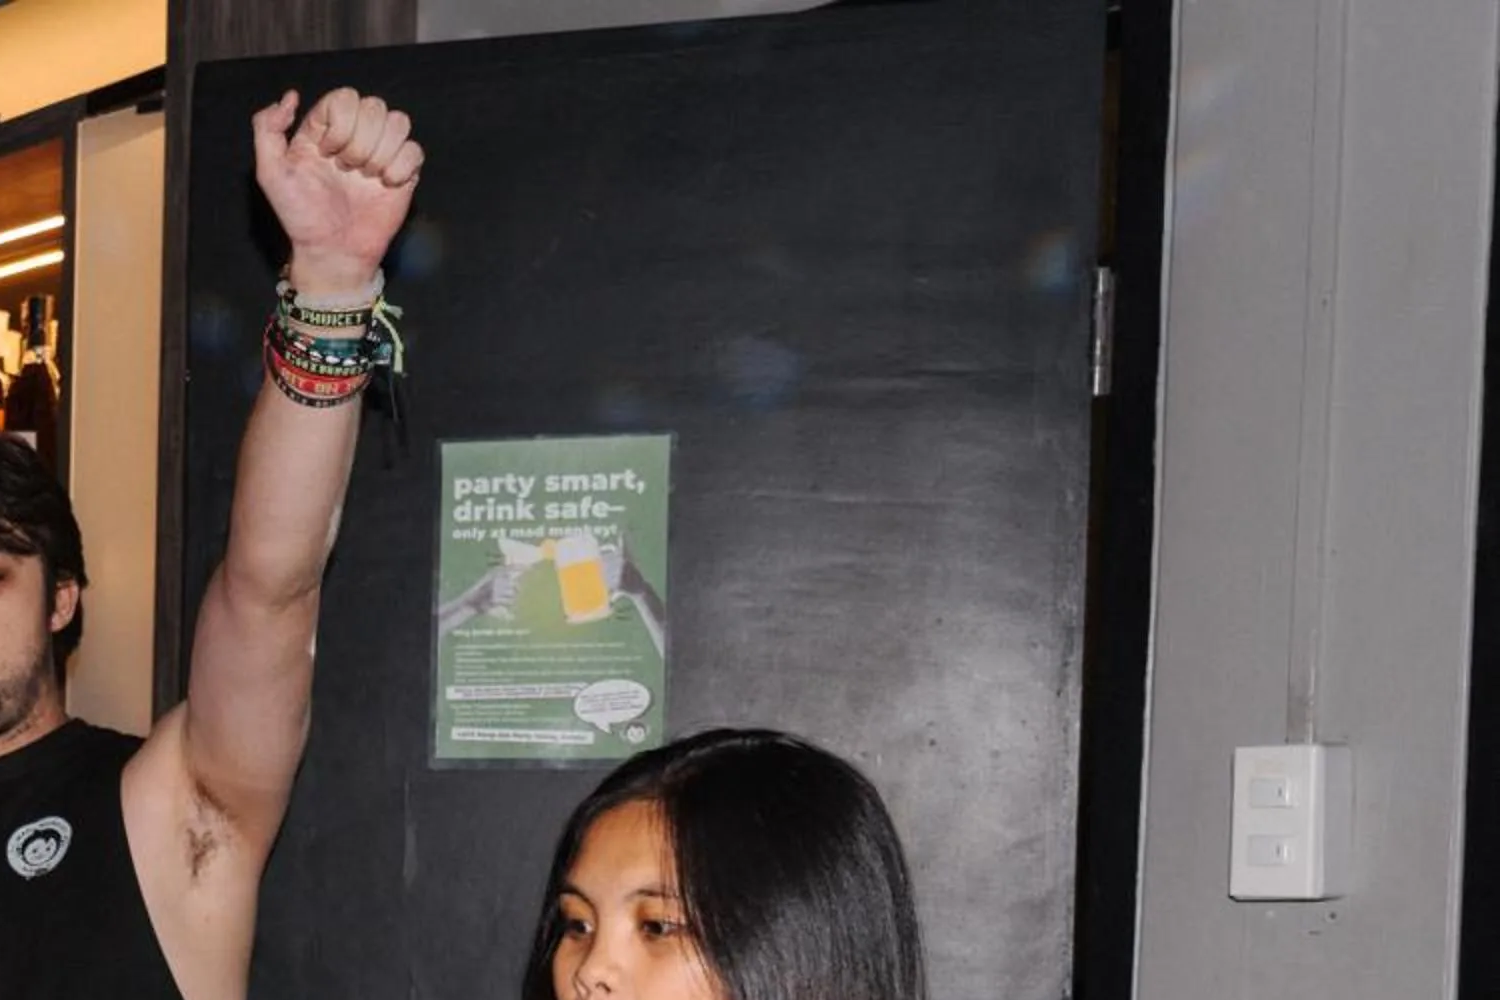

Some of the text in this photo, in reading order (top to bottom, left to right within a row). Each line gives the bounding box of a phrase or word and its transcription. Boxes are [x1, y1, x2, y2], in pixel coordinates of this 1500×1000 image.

[300, 308, 362, 327] PHUKET
[453, 468, 646, 500] party smart,
[452, 497, 535, 522] drink
[452, 526, 487, 542] only
[490, 526, 507, 539] at
[509, 525, 545, 538] mad
